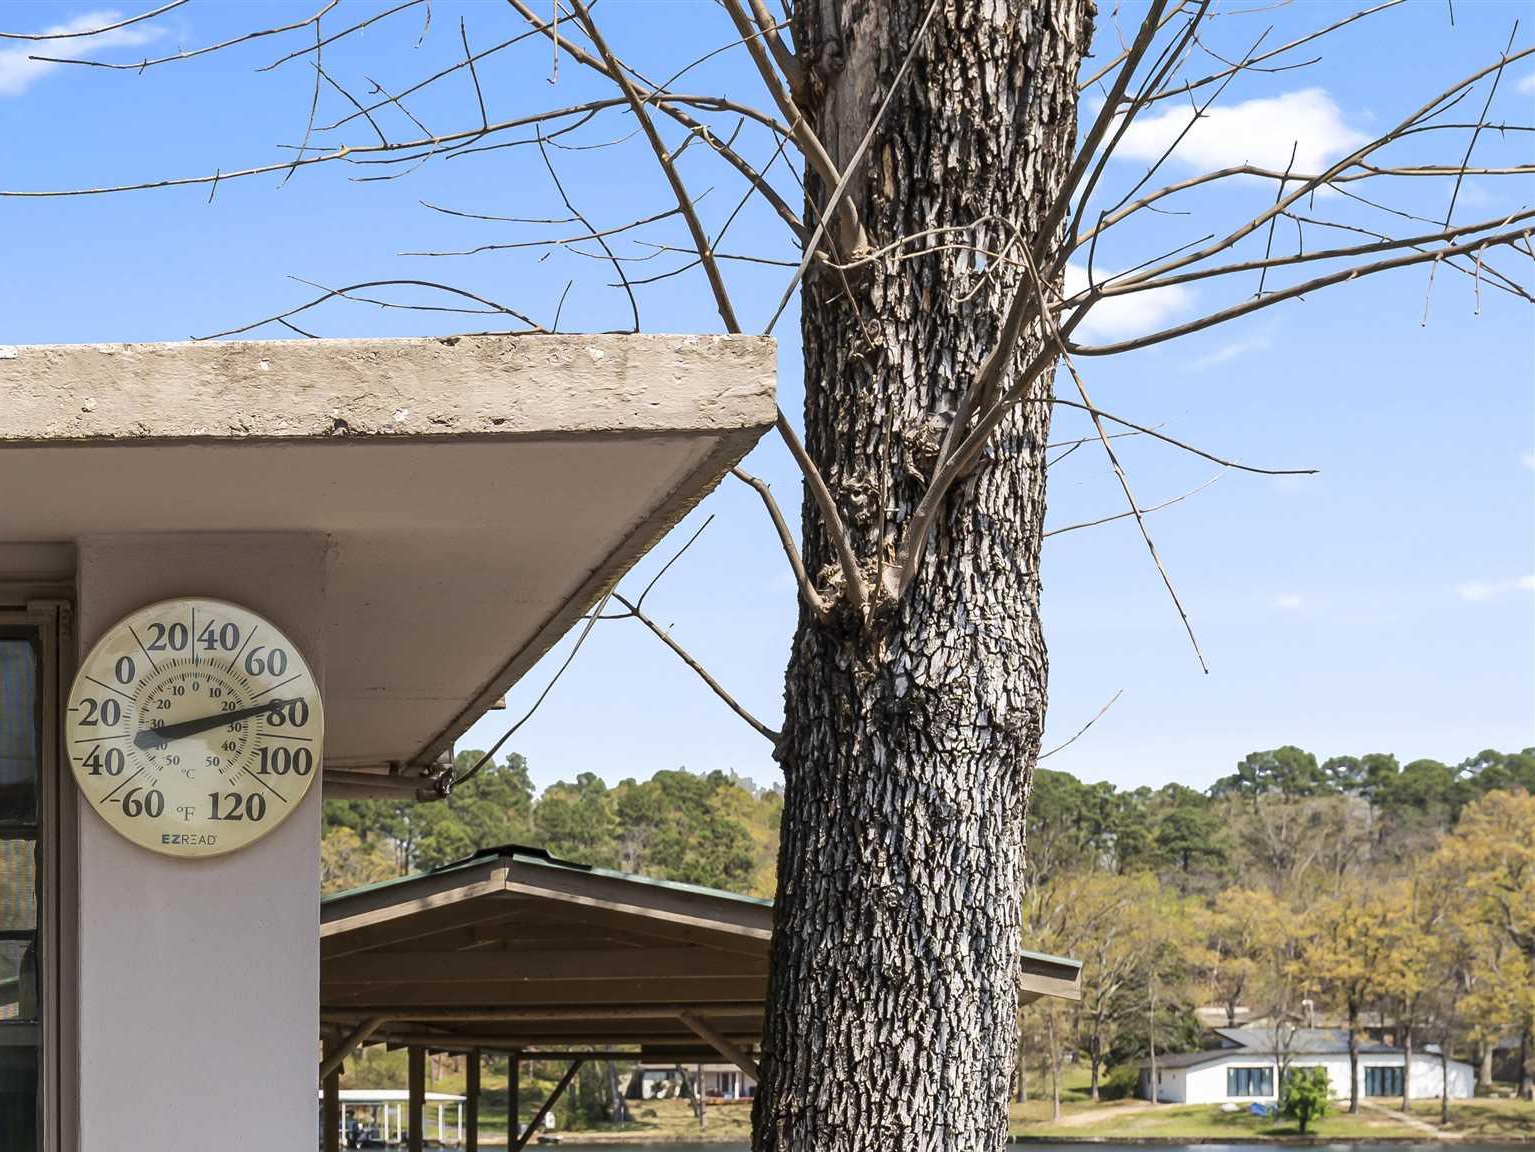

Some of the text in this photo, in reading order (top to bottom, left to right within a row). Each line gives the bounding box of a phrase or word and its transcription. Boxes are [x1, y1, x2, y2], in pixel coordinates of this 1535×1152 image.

[146, 622, 189, 651] 20
[196, 619, 240, 651] 40
[115, 655, 136, 684] 0
[244, 645, 288, 676] 60
[209, 687, 222, 698] 10
[221, 701, 236, 711] 20
[266, 697, 309, 728] 80
[221, 741, 236, 752] 40
[256, 746, 313, 776] 100
[205, 756, 220, 767] 50
[207, 791, 266, 822] 120
